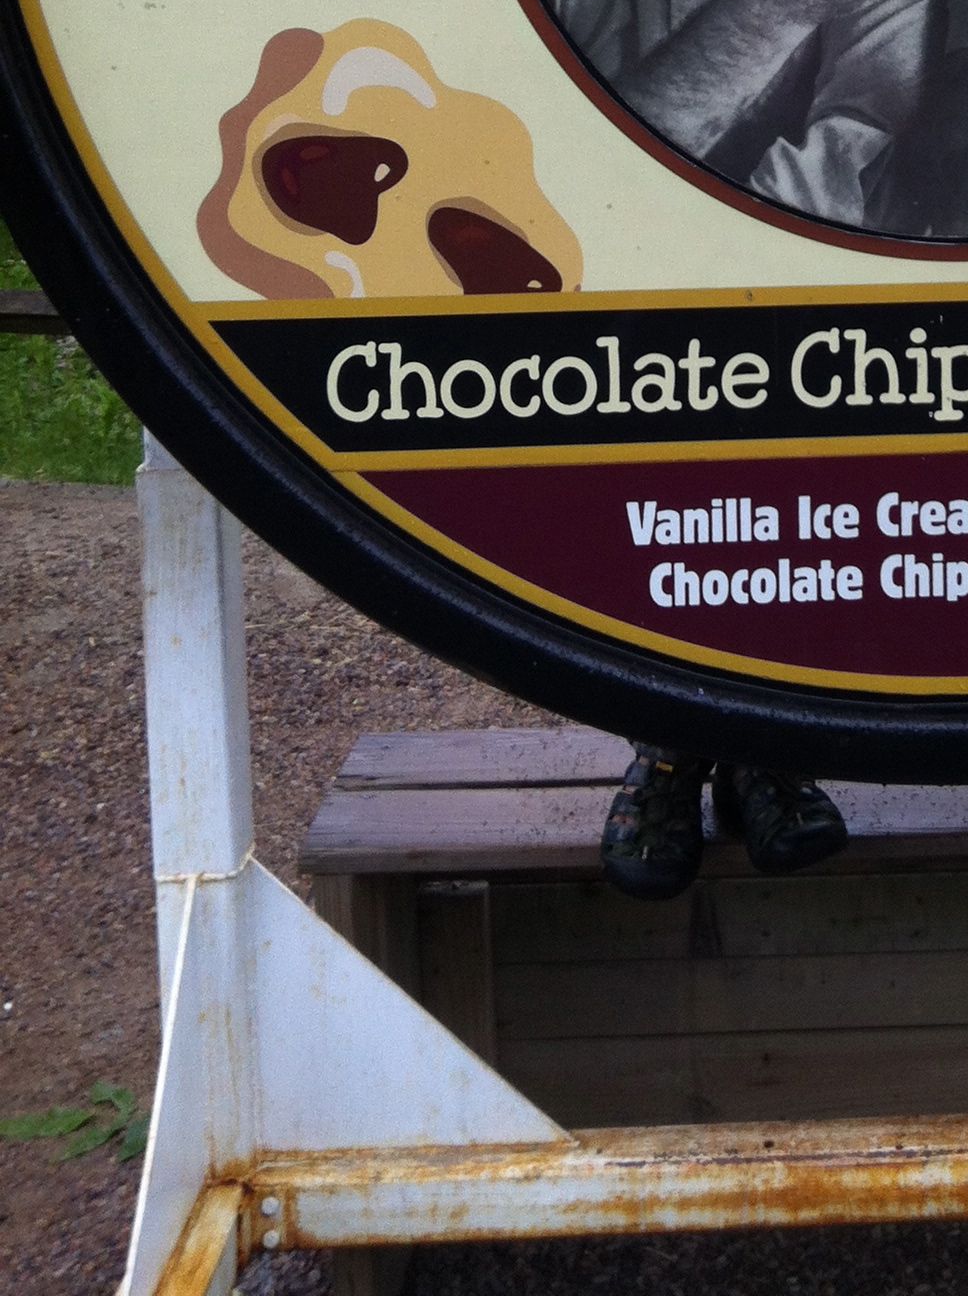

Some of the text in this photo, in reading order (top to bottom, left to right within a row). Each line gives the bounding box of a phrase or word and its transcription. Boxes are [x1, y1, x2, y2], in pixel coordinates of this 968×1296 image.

[326, 336, 770, 423] Chocolate
[625, 497, 780, 546] Vanilla
[798, 495, 860, 540] Ice
[649, 558, 864, 608] Chocolate
